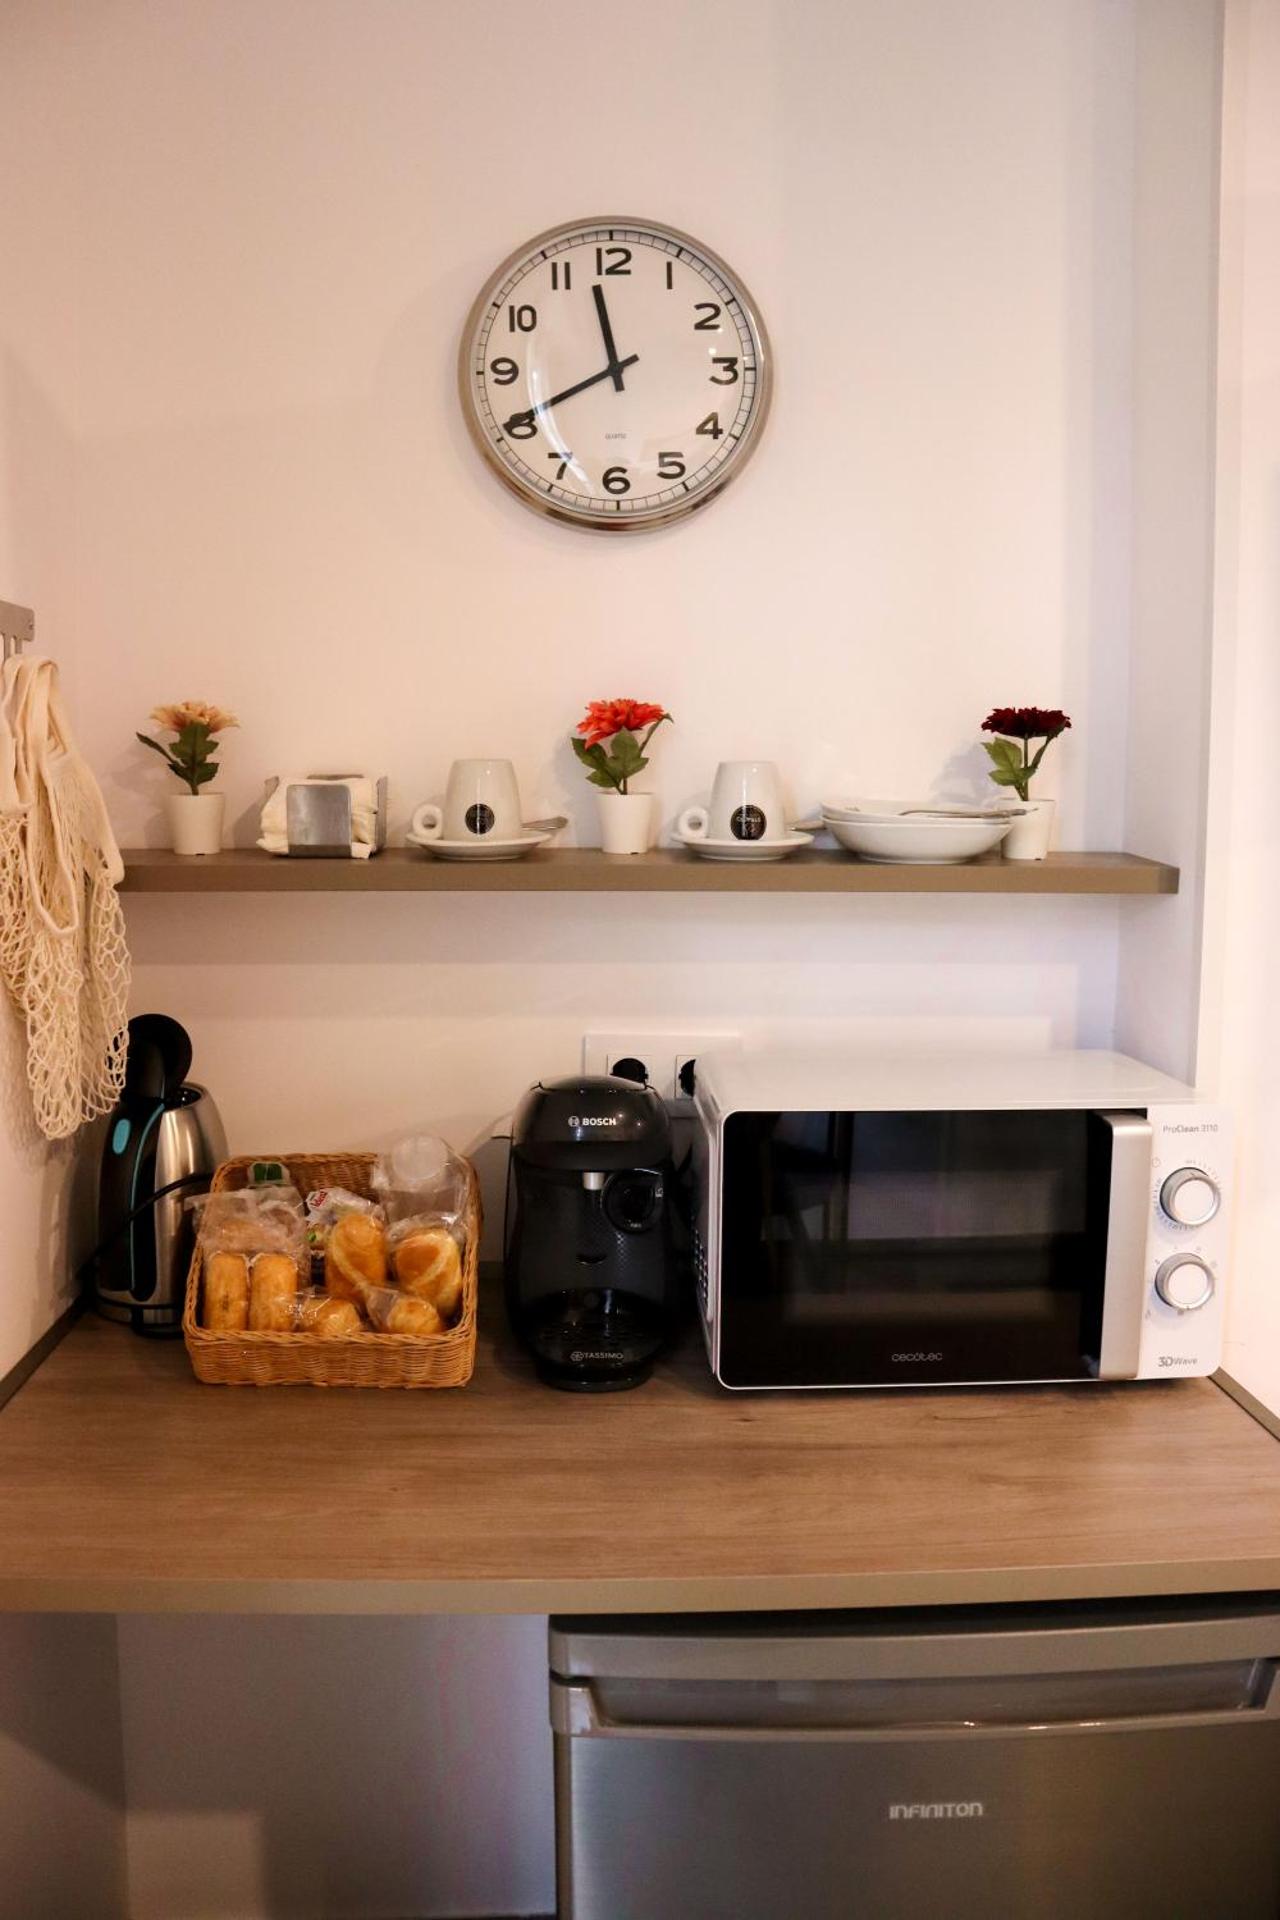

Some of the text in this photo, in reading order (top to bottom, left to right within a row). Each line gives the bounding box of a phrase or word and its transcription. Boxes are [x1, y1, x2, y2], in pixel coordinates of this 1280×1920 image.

[551, 261, 571, 290] 11
[596, 247, 632, 276] 12
[666, 261, 673, 290] 1
[509, 305, 537, 332] 10
[694, 302, 722, 330] 2
[490, 357, 519, 385] 9
[709, 357, 738, 385] 3
[509, 411, 538, 440] 8
[695, 412, 724, 440] 4
[547, 452, 574, 480] 7
[656, 452, 686, 480] 5
[602, 466, 631, 495] 6
[582, 1117, 617, 1126] BOSCH
[1162, 1124, 1199, 1133] ProClean
[583, 1352, 624, 1360] TASSIMO
